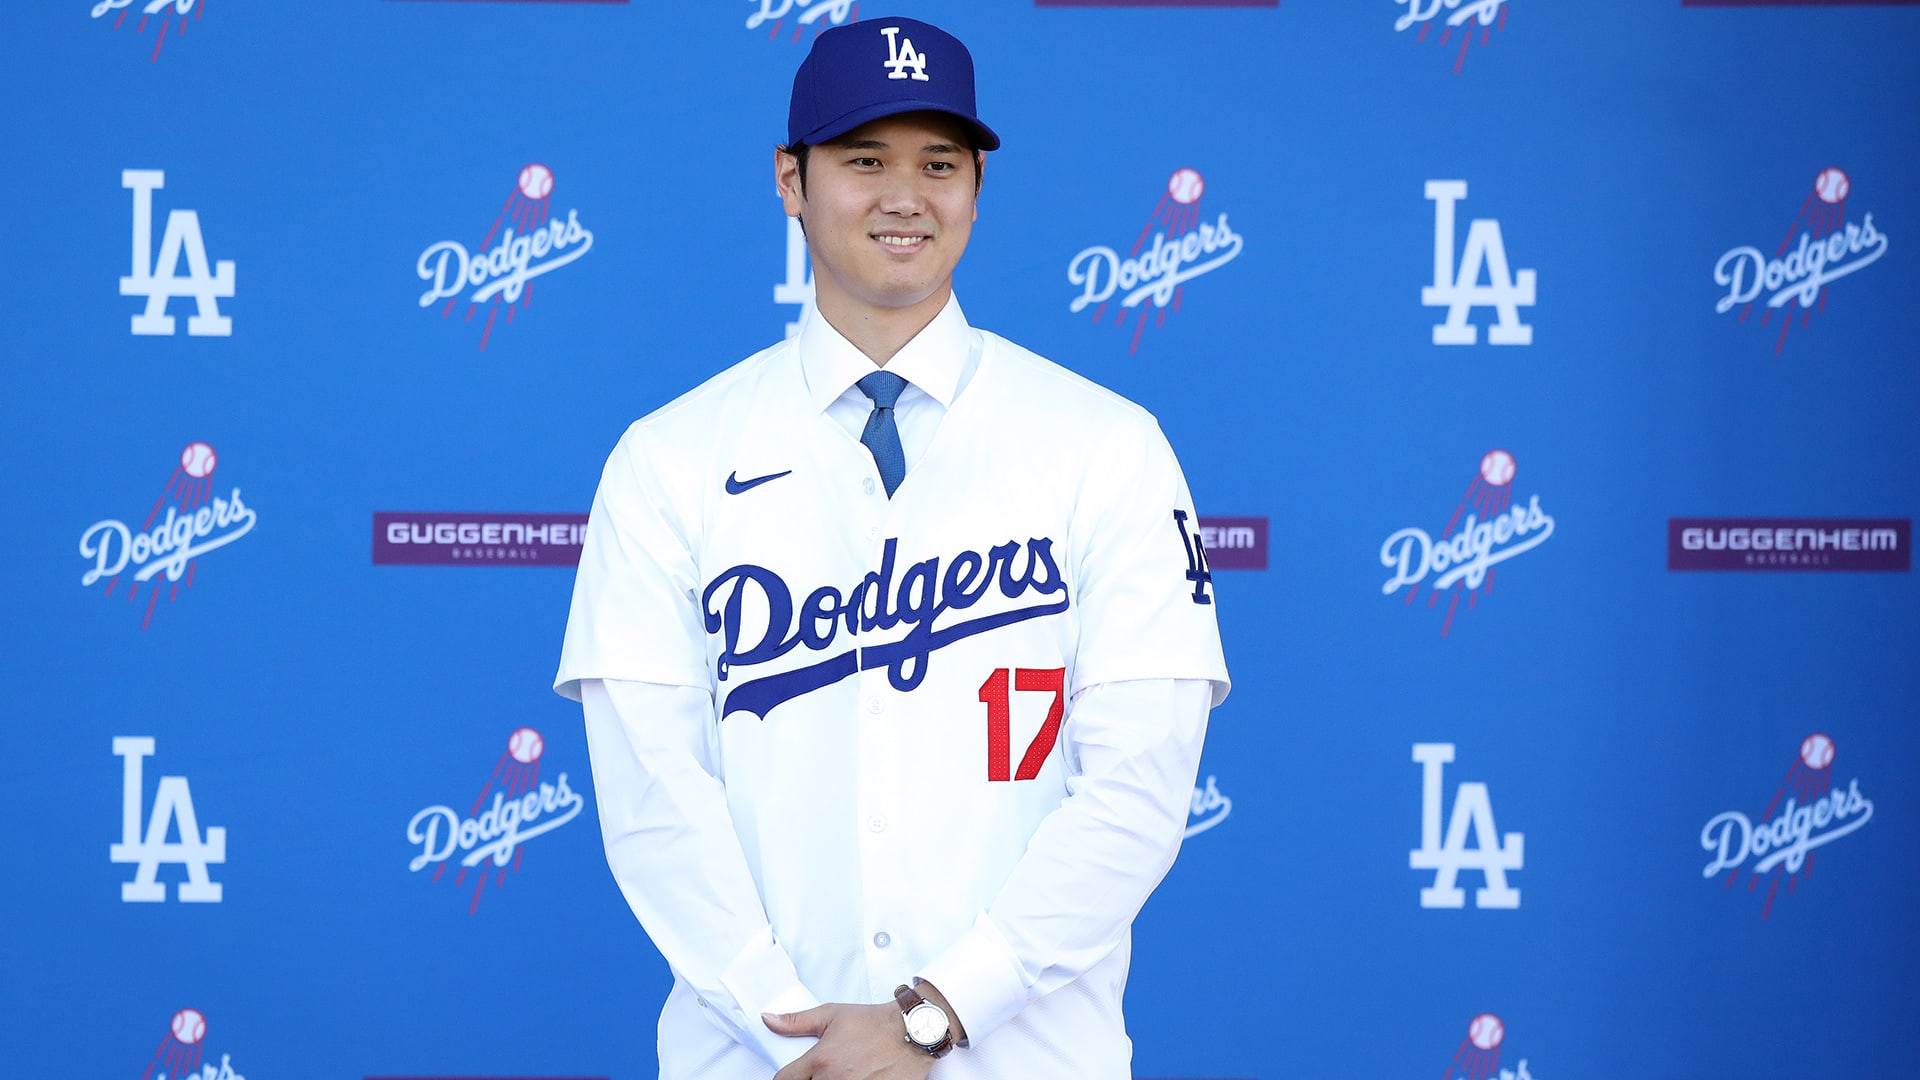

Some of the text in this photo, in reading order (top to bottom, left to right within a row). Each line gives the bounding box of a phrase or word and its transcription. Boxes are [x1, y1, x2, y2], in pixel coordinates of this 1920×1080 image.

[880, 27, 930, 82] LA
[120, 170, 235, 336] LA
[417, 209, 594, 308] Dodgers
[1067, 213, 1243, 313] Dodgers
[1421, 180, 1536, 345] LA
[1713, 213, 1888, 314] Dodgers
[79, 487, 257, 586] Dodgers
[1380, 495, 1555, 595] Dodgers
[1681, 527, 1898, 551] GUGGENHEIM
[702, 537, 1070, 721] Dodgers
[978, 667, 1066, 782] 17
[110, 736, 226, 903] LA
[407, 773, 584, 872] Dodgers
[1409, 743, 1524, 909] LA
[1700, 779, 1874, 878] Dodgers
